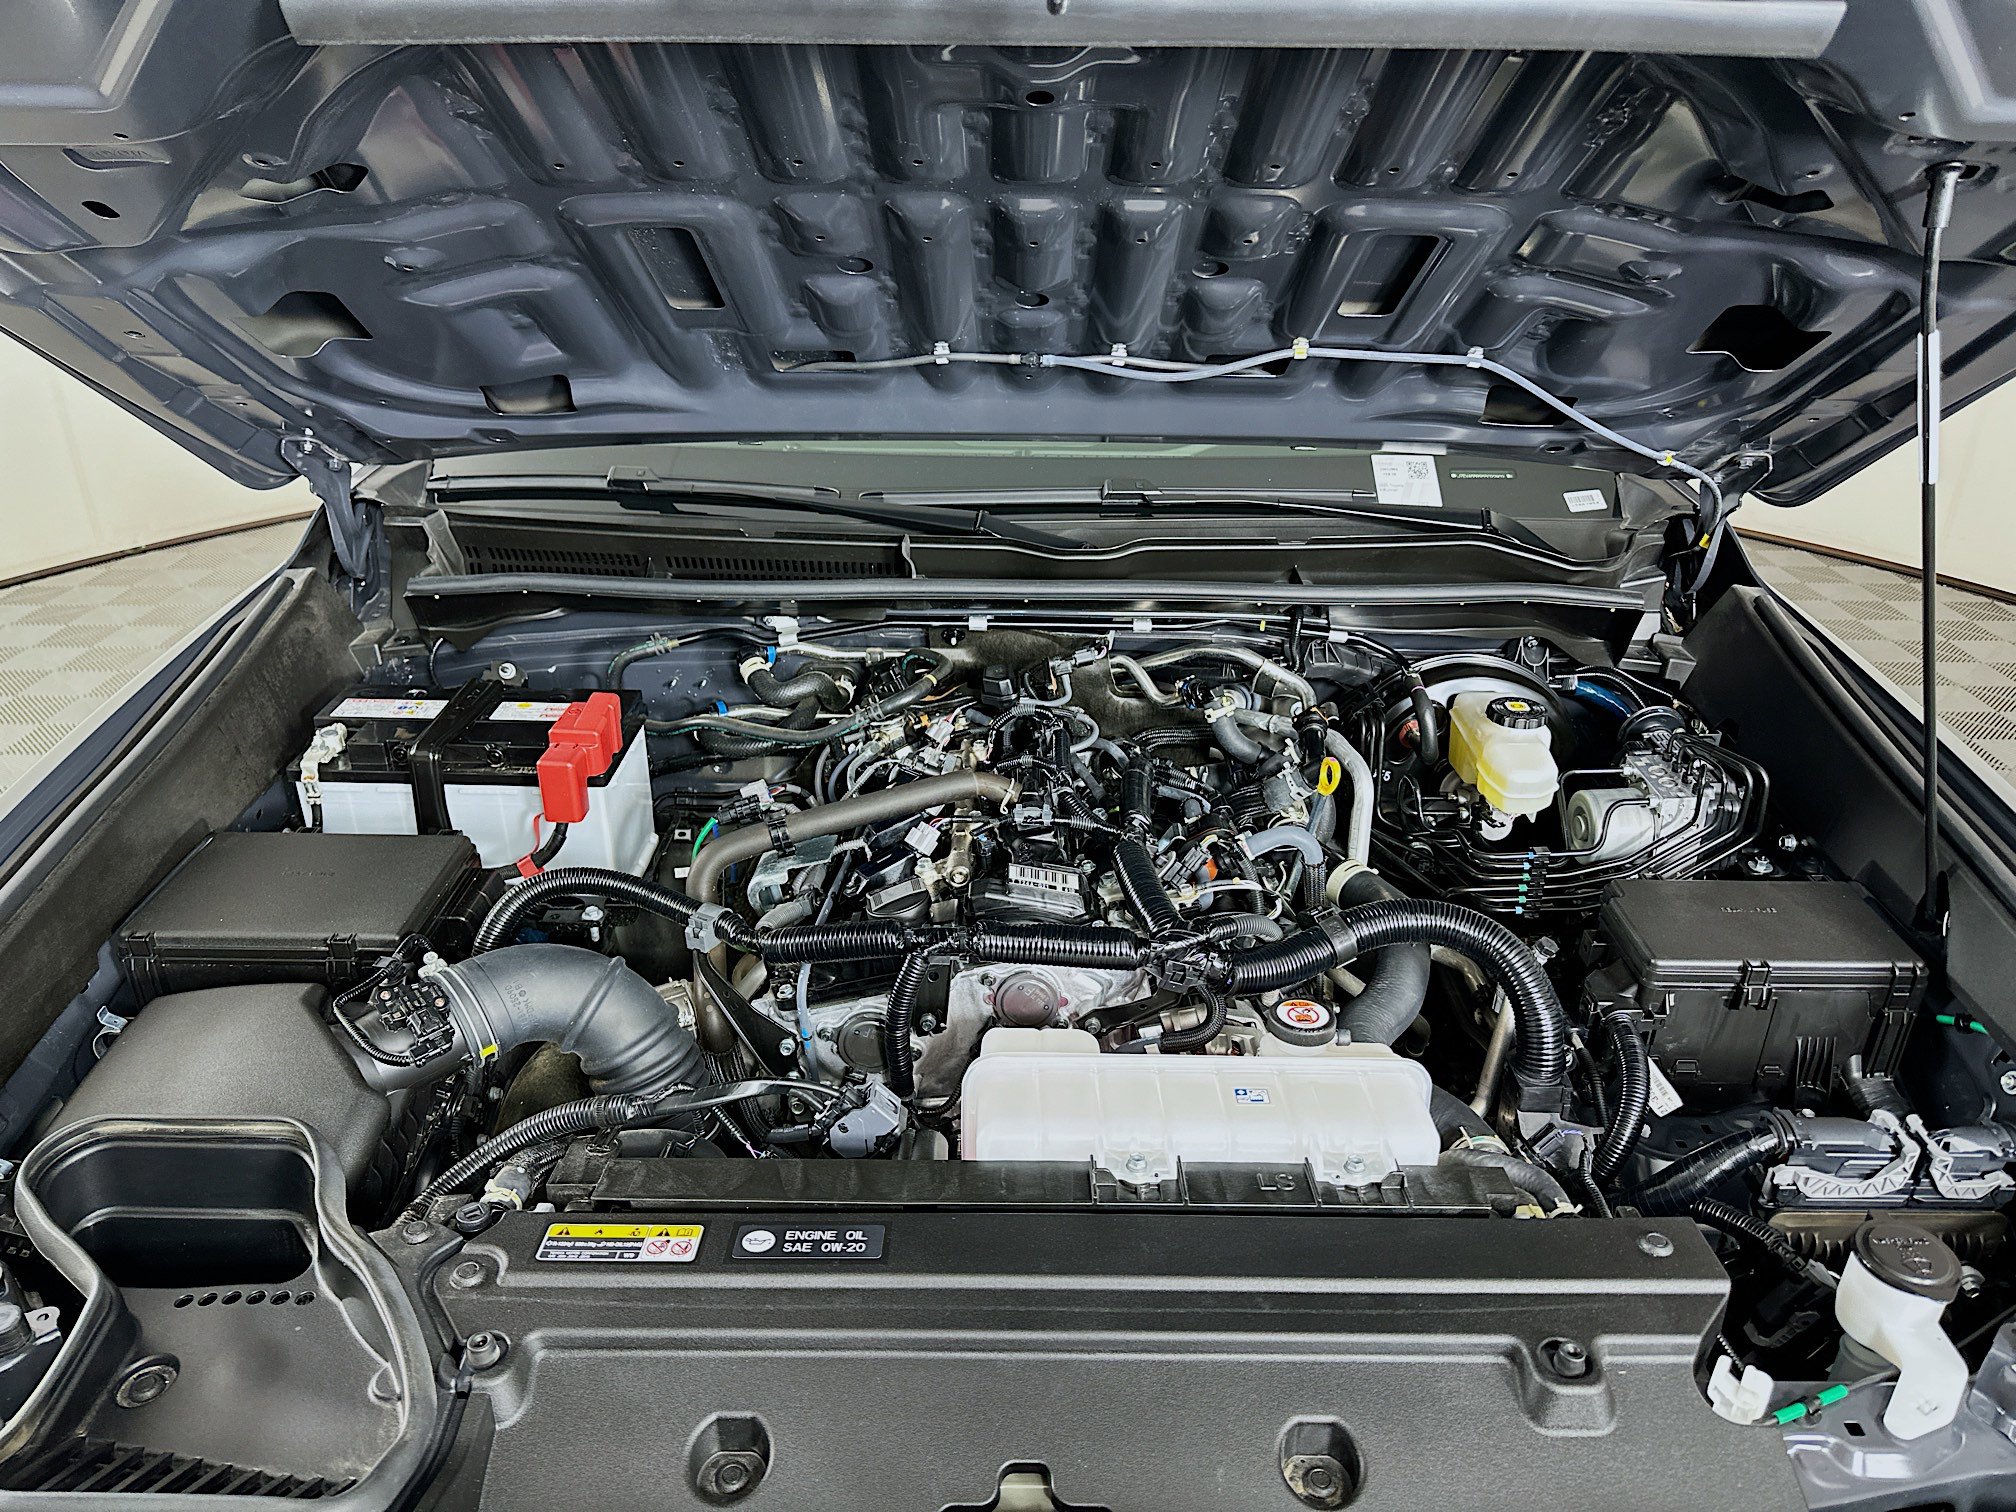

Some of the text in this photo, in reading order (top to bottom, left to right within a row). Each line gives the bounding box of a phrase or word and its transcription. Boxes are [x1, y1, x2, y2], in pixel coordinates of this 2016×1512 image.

[1256, 1172, 1296, 1191] LS
[785, 1230, 868, 1241] ENGINE OIL
[782, 1242, 866, 1253] SAE 0W-20
